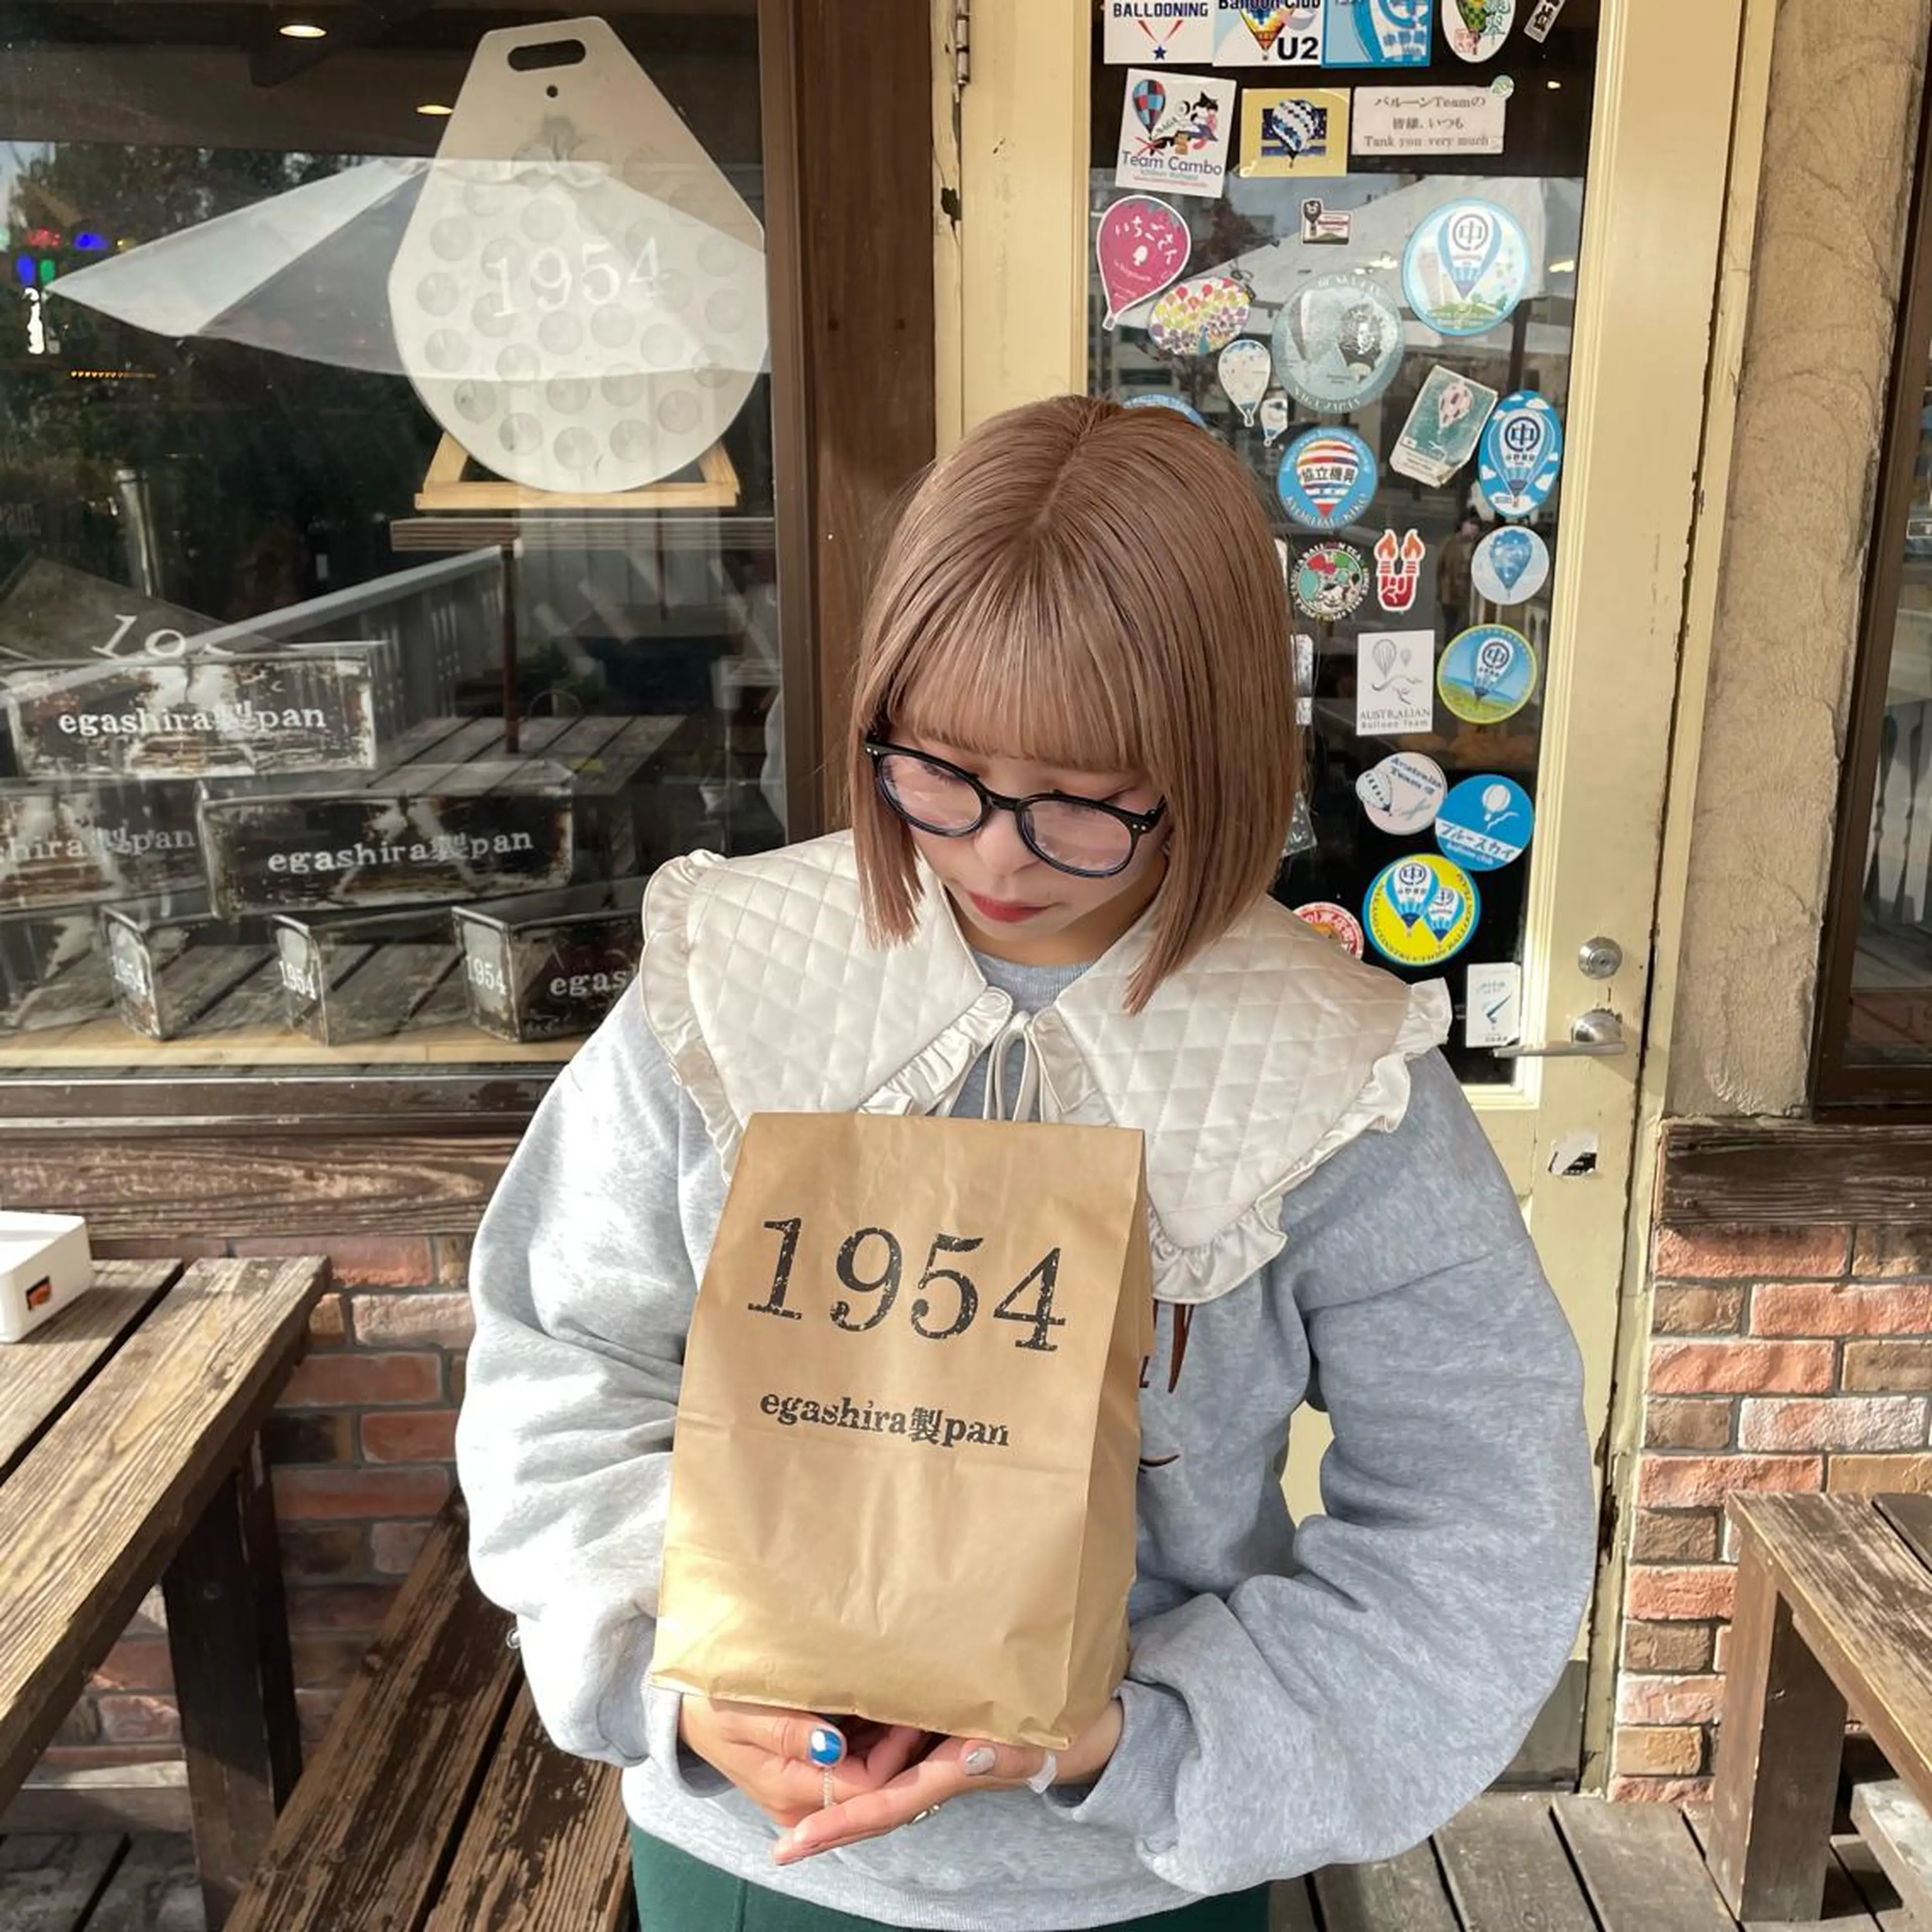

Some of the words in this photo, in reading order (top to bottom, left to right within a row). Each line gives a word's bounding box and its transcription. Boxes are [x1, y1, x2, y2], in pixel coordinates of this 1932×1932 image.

[1113, 2, 1208, 18] BALLOONING
[1277, 38, 1319, 60] U2
[1364, 135, 1395, 147] Tank
[1398, 137, 1422, 148] you
[1428, 137, 1454, 147] very
[1457, 136, 1489, 146] much
[1122, 151, 1164, 169] Team
[1168, 156, 1223, 176] Cambo
[485, 234, 671, 318] 1954
[465, 955, 507, 996] 1954
[748, 1217, 1065, 1352] 1954
[760, 1393, 1009, 1447] egashira製pan
